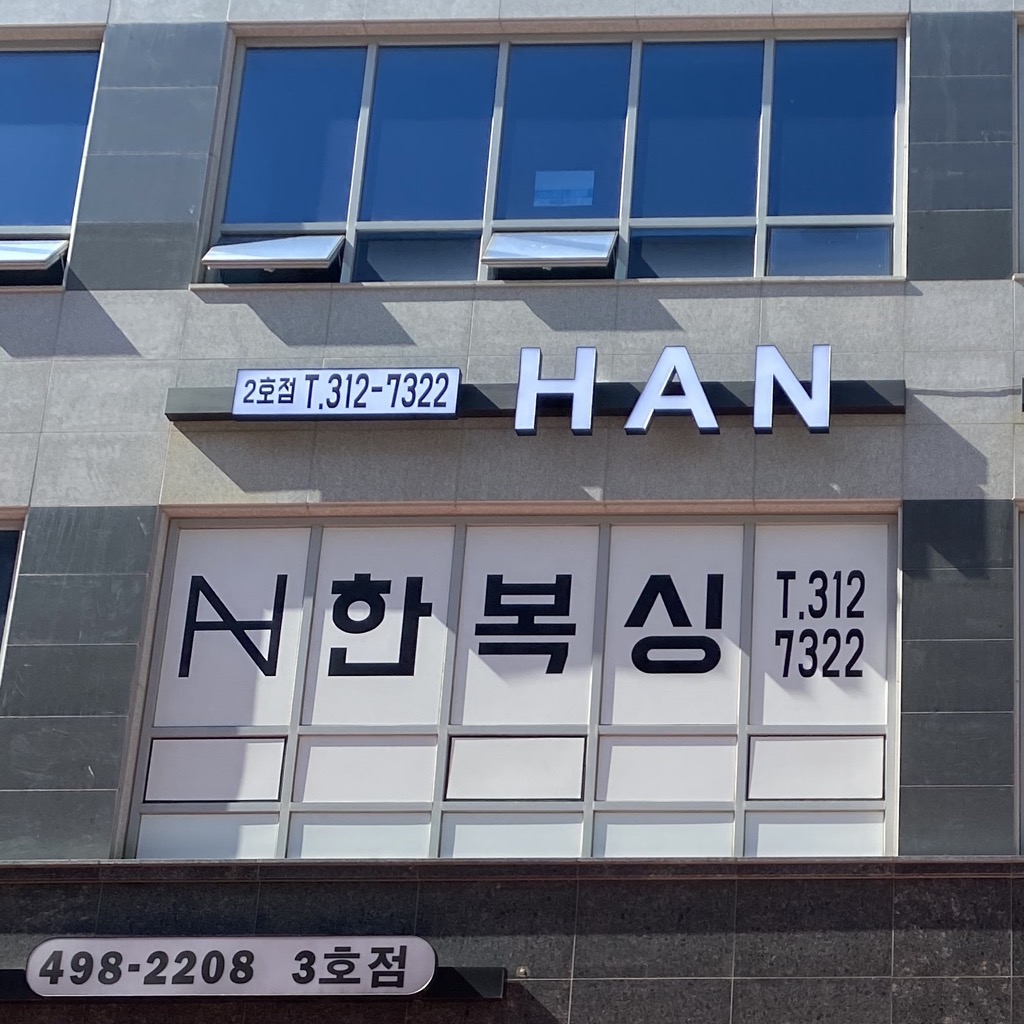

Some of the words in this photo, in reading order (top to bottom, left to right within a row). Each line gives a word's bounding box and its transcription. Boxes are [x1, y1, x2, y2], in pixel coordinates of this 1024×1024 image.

[243, 376, 297, 405] 2호점
[303, 372, 450, 410] T.312-7322
[513, 344, 832, 436] HAN
[776, 569, 866, 621] T.312
[328, 573, 724, 677] 한복싱
[774, 628, 865, 679] 7322
[39, 950, 255, 986] 498-2208
[291, 944, 408, 989] 3호점
